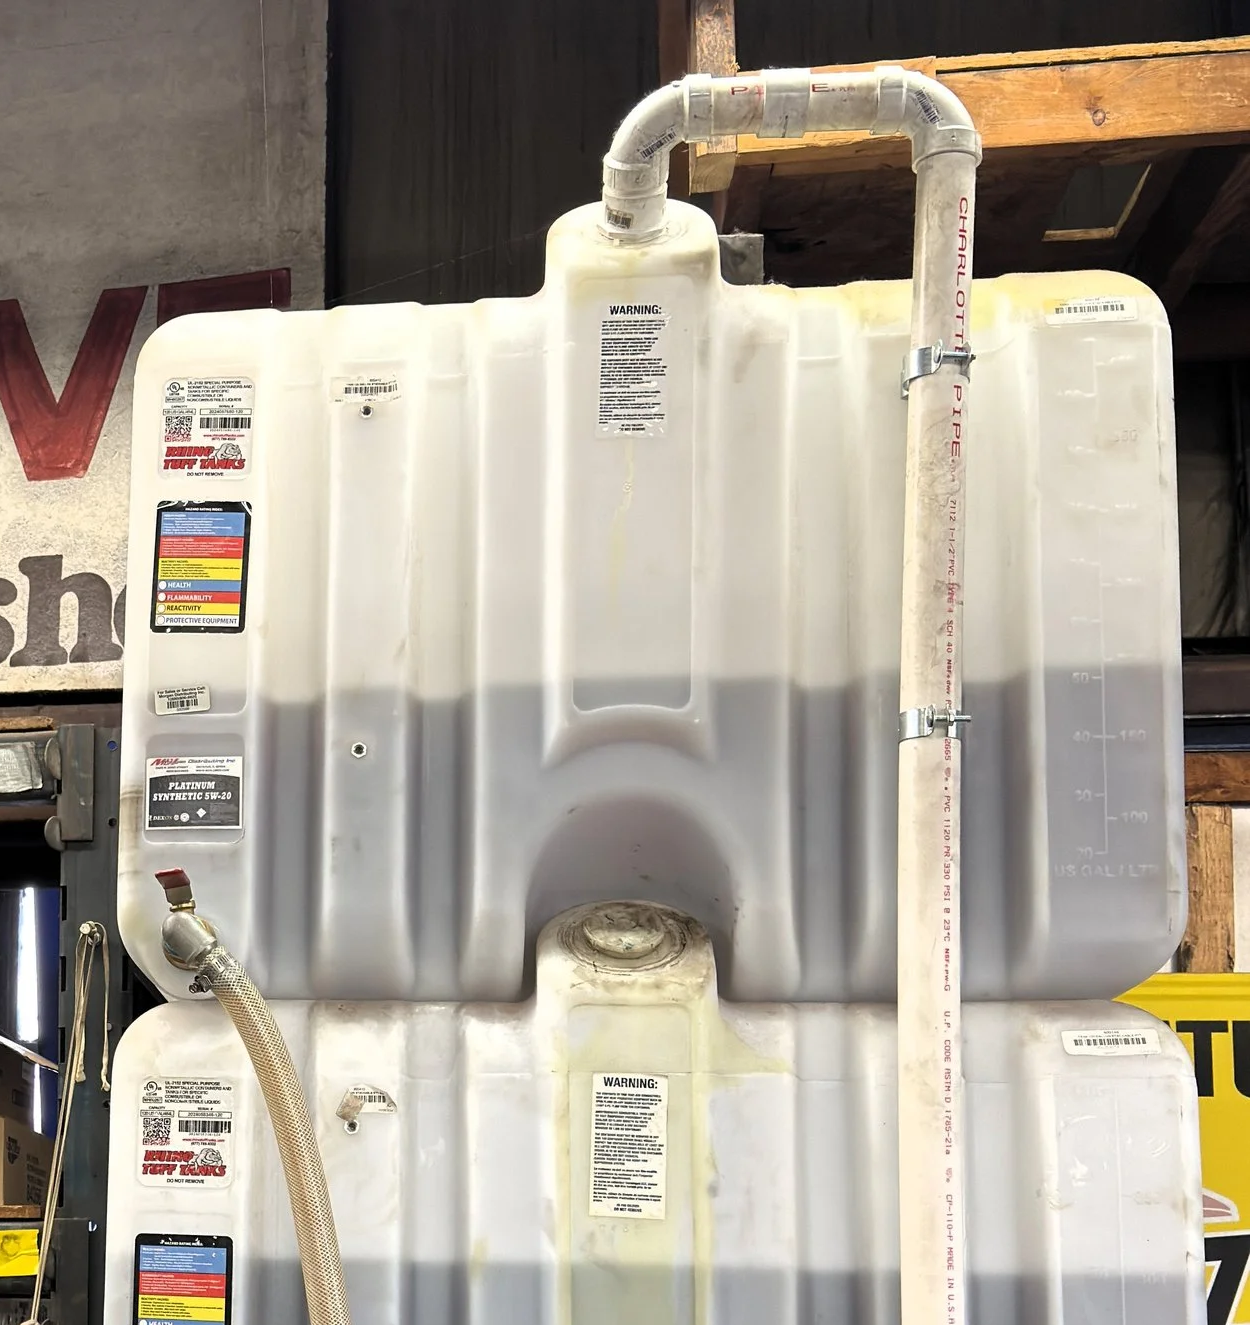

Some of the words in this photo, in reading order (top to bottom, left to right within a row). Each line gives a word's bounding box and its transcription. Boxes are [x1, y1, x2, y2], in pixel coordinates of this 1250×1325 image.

[609, 304, 662, 316] WARNING:
[950, 384, 963, 458] PIPE
[163, 459, 198, 470] TUFF
[200, 459, 246, 470] TANKS
[168, 781, 215, 790] PLATINUM
[152, 791, 203, 801] SYNTHETIC
[204, 791, 232, 800] 5W-20
[943, 1039, 951, 1063] CODE
[603, 1076, 658, 1089] WARNING:
[944, 1068, 952, 1091] ASTM
[179, 1164, 226, 1177] TANKS
